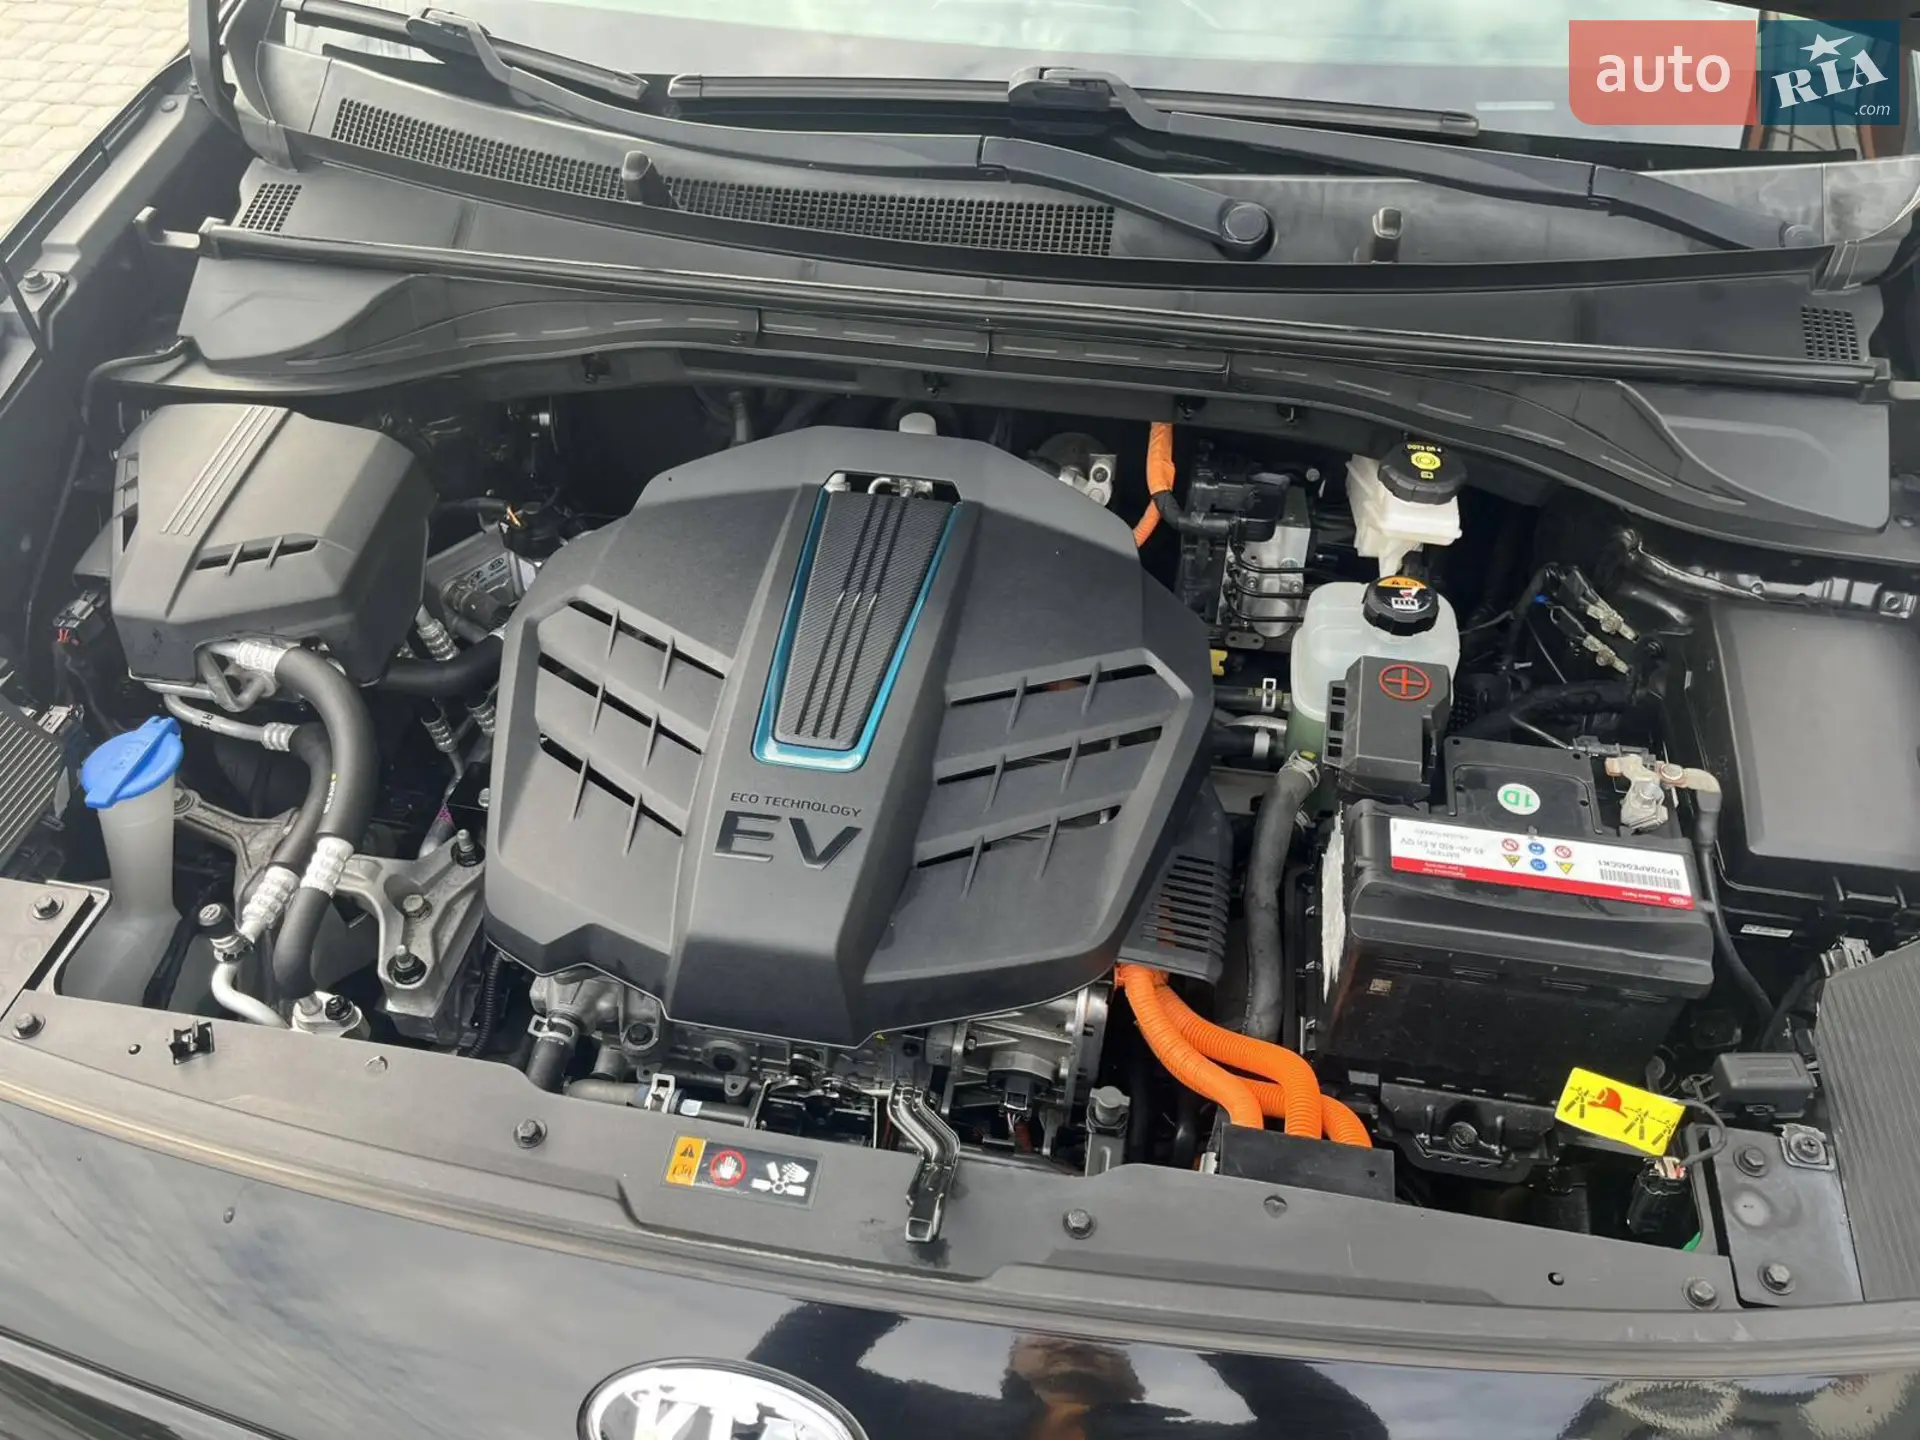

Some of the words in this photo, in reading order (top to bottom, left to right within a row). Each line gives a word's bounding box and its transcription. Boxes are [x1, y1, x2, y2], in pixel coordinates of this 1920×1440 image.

[730, 792, 759, 804] ECO
[765, 796, 862, 817] TECHNOLOGY
[1503, 790, 1533, 808] 1D
[713, 810, 863, 871] EV
